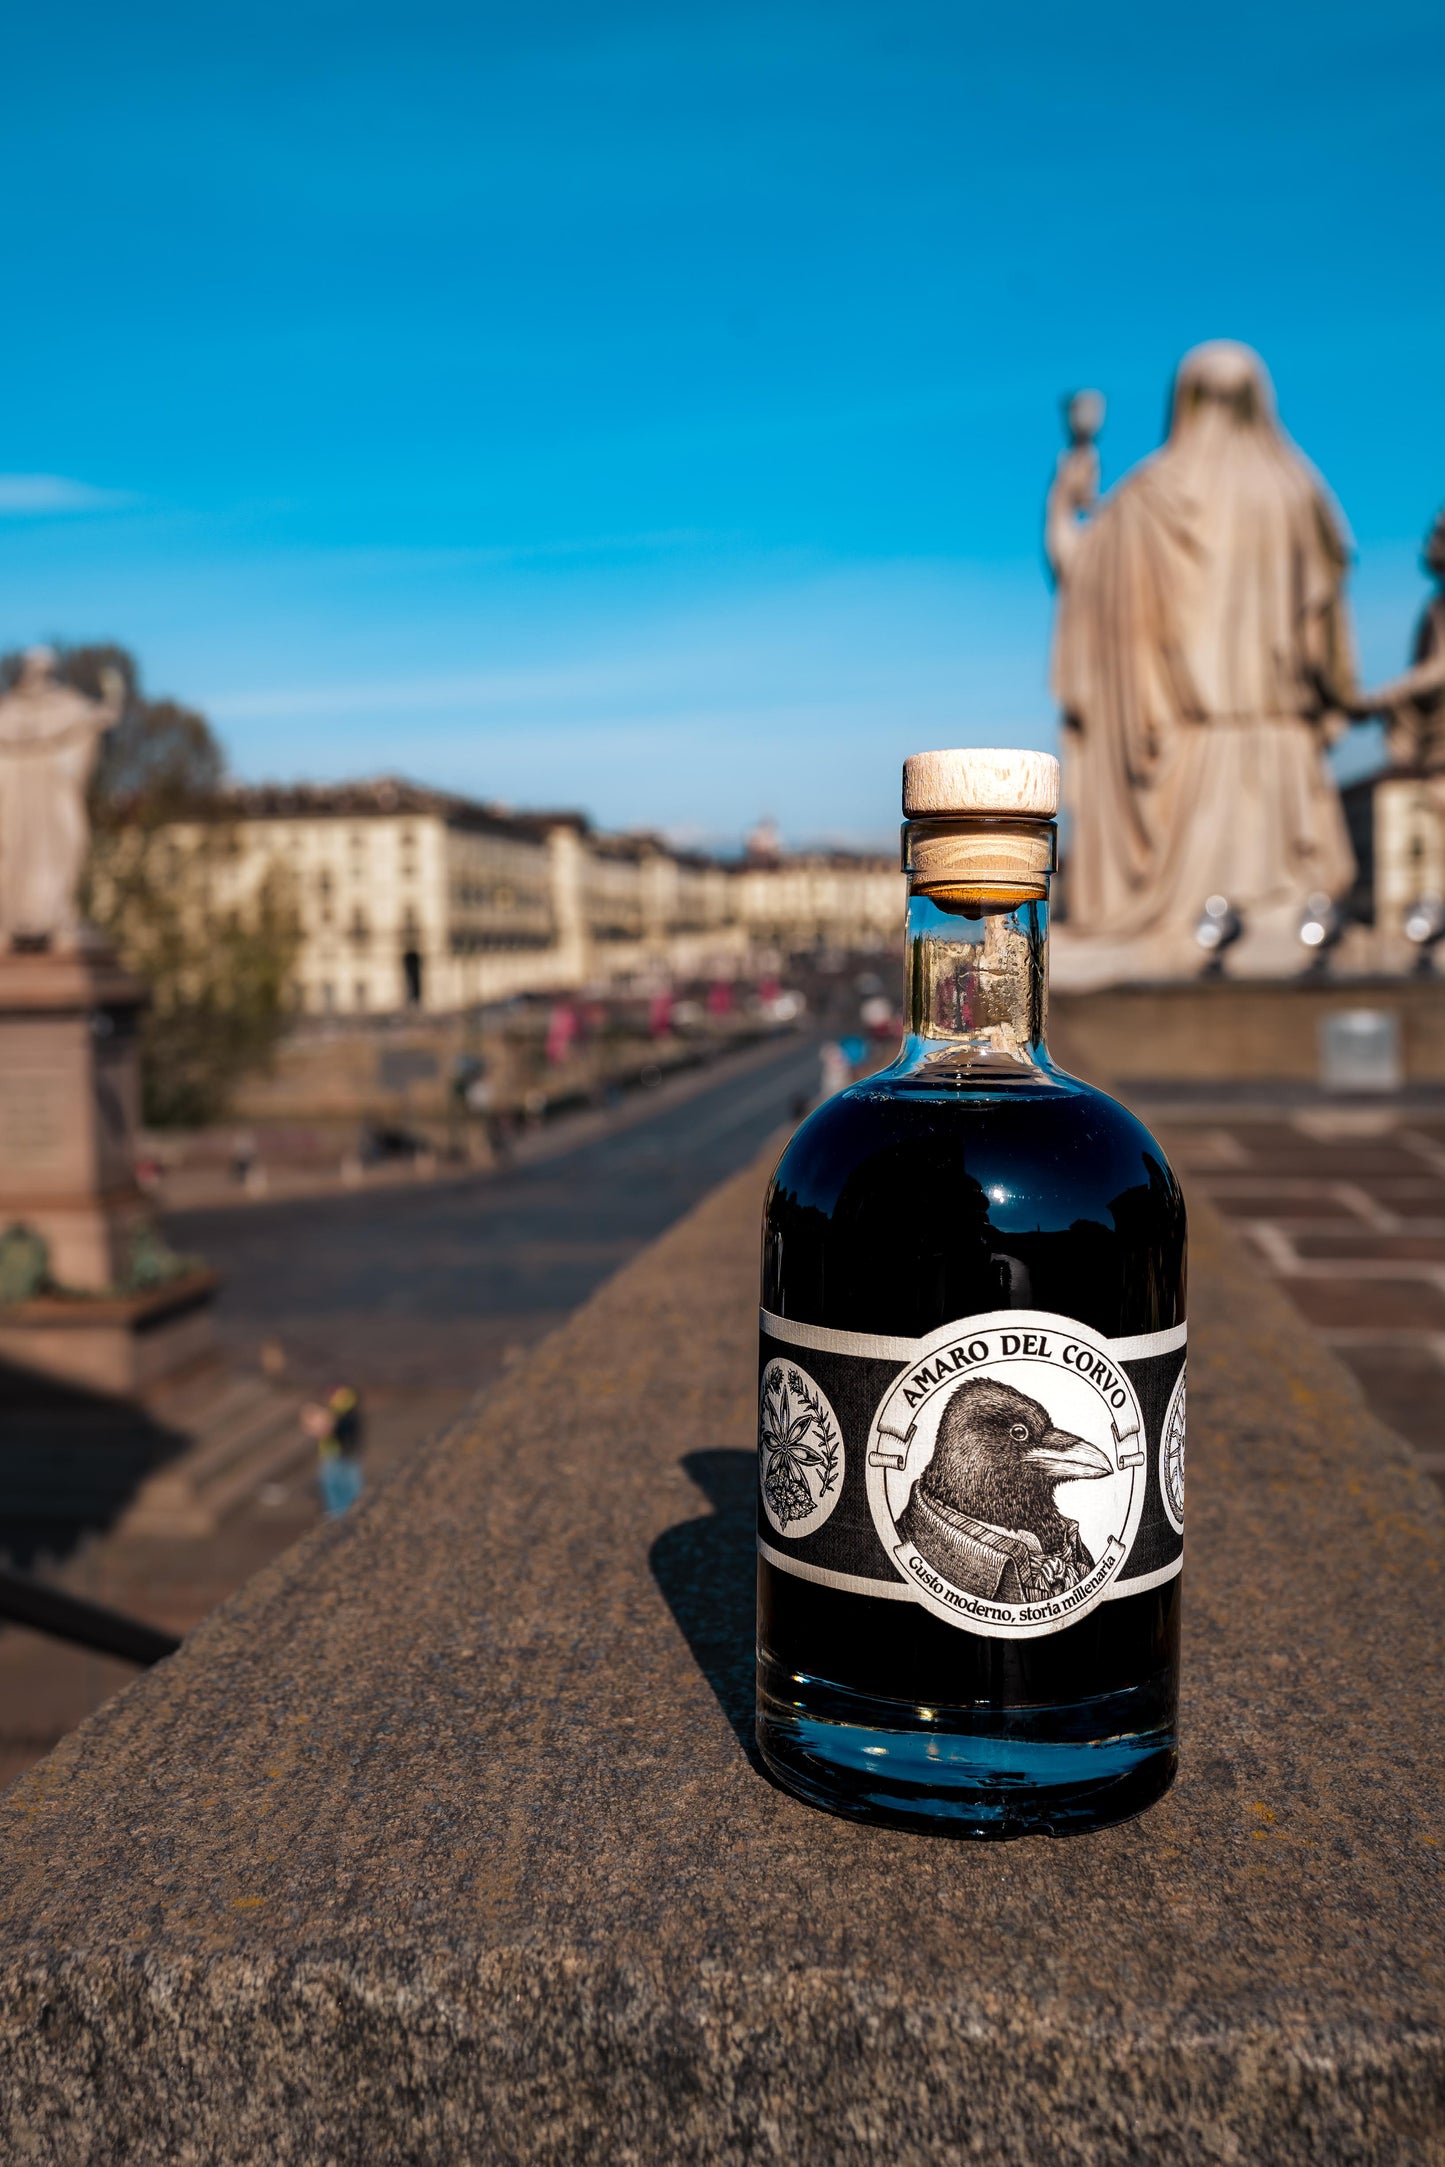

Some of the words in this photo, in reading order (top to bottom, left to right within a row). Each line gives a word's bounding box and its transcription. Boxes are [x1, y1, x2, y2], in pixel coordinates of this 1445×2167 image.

[902, 1340, 989, 1409] AMARO
[1000, 1334, 1053, 1358] DEL
[1062, 1344, 1127, 1409] CORVO
[908, 1556, 945, 1594] Gusto
[943, 1588, 1016, 1623] moderno,
[1019, 1602, 1062, 1621] storia
[1062, 1555, 1116, 1611] millenaria
